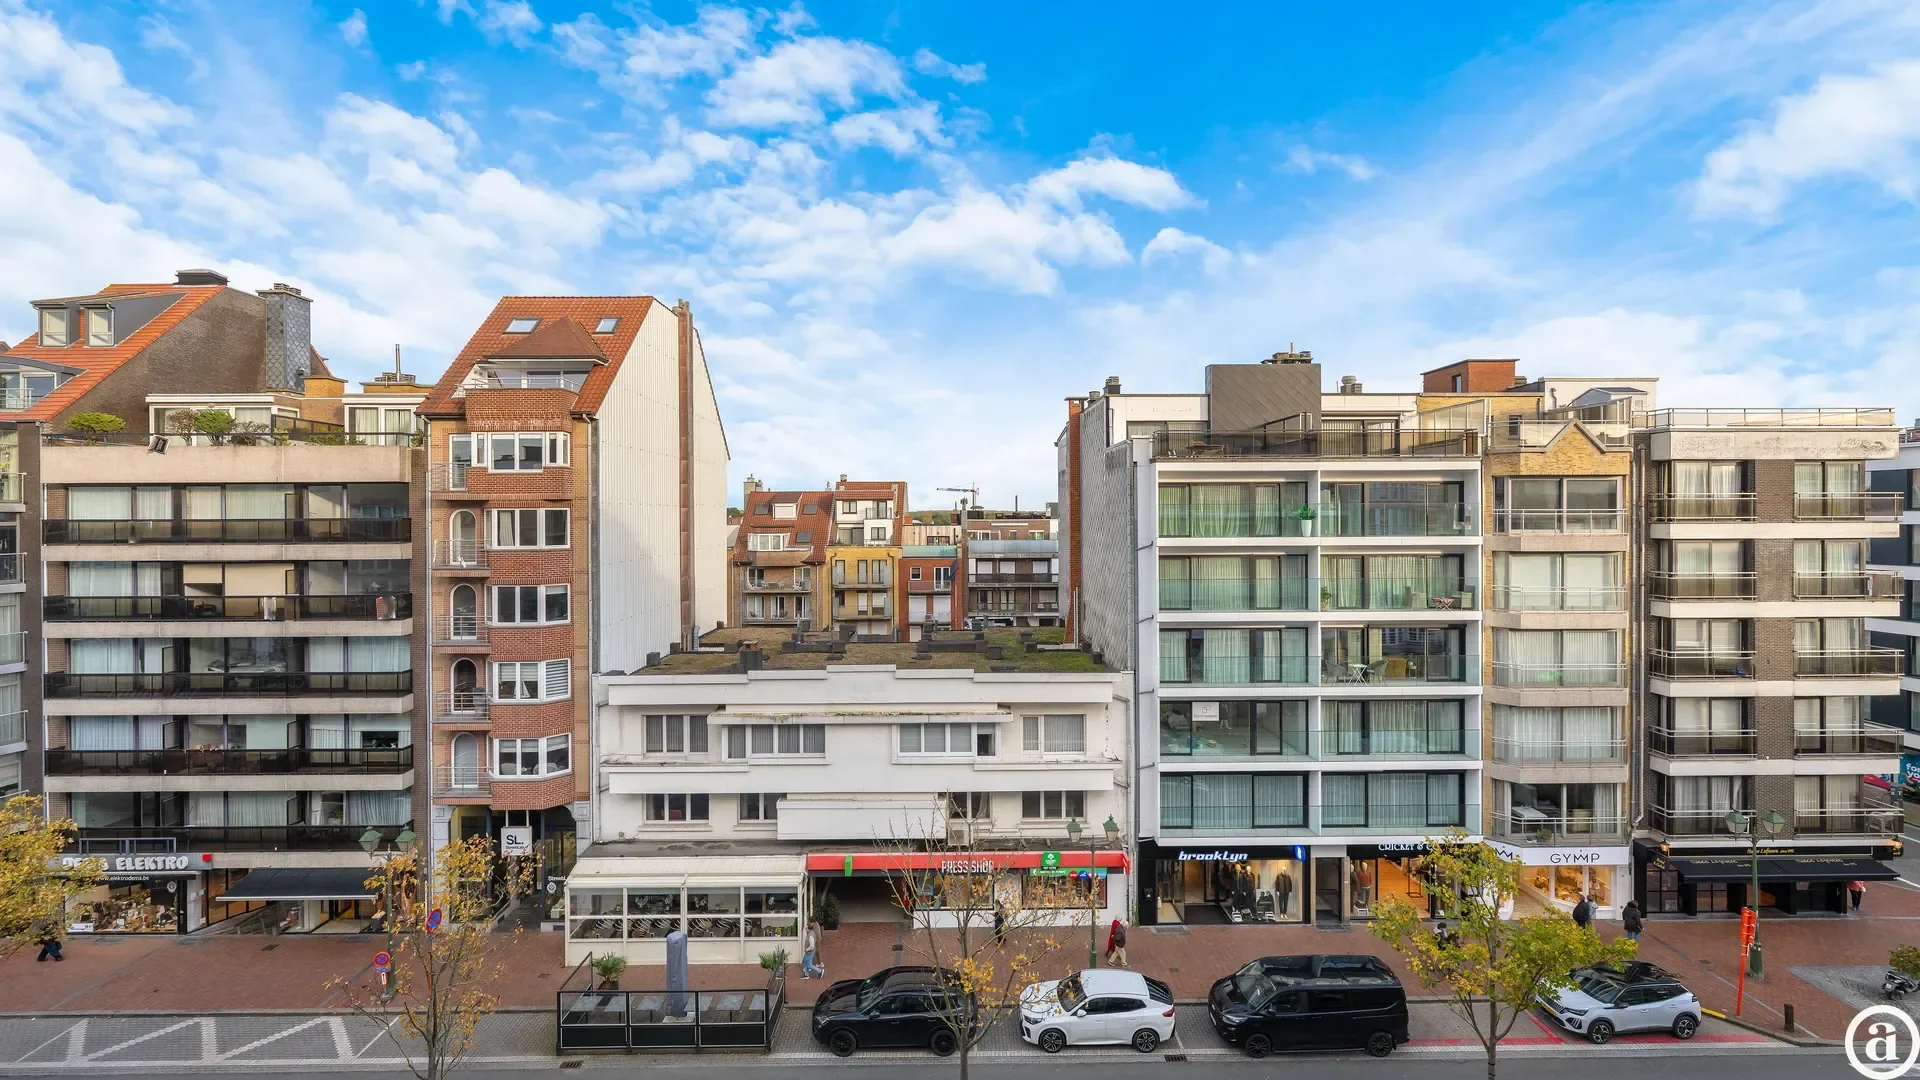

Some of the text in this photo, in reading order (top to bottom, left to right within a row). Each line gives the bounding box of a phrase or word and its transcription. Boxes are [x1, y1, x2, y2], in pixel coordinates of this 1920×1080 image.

[1378, 843, 1414, 851] CRICKET
[1416, 843, 1424, 851] &
[116, 855, 189, 871] ELEKTRO
[941, 860, 969, 874] PRESS
